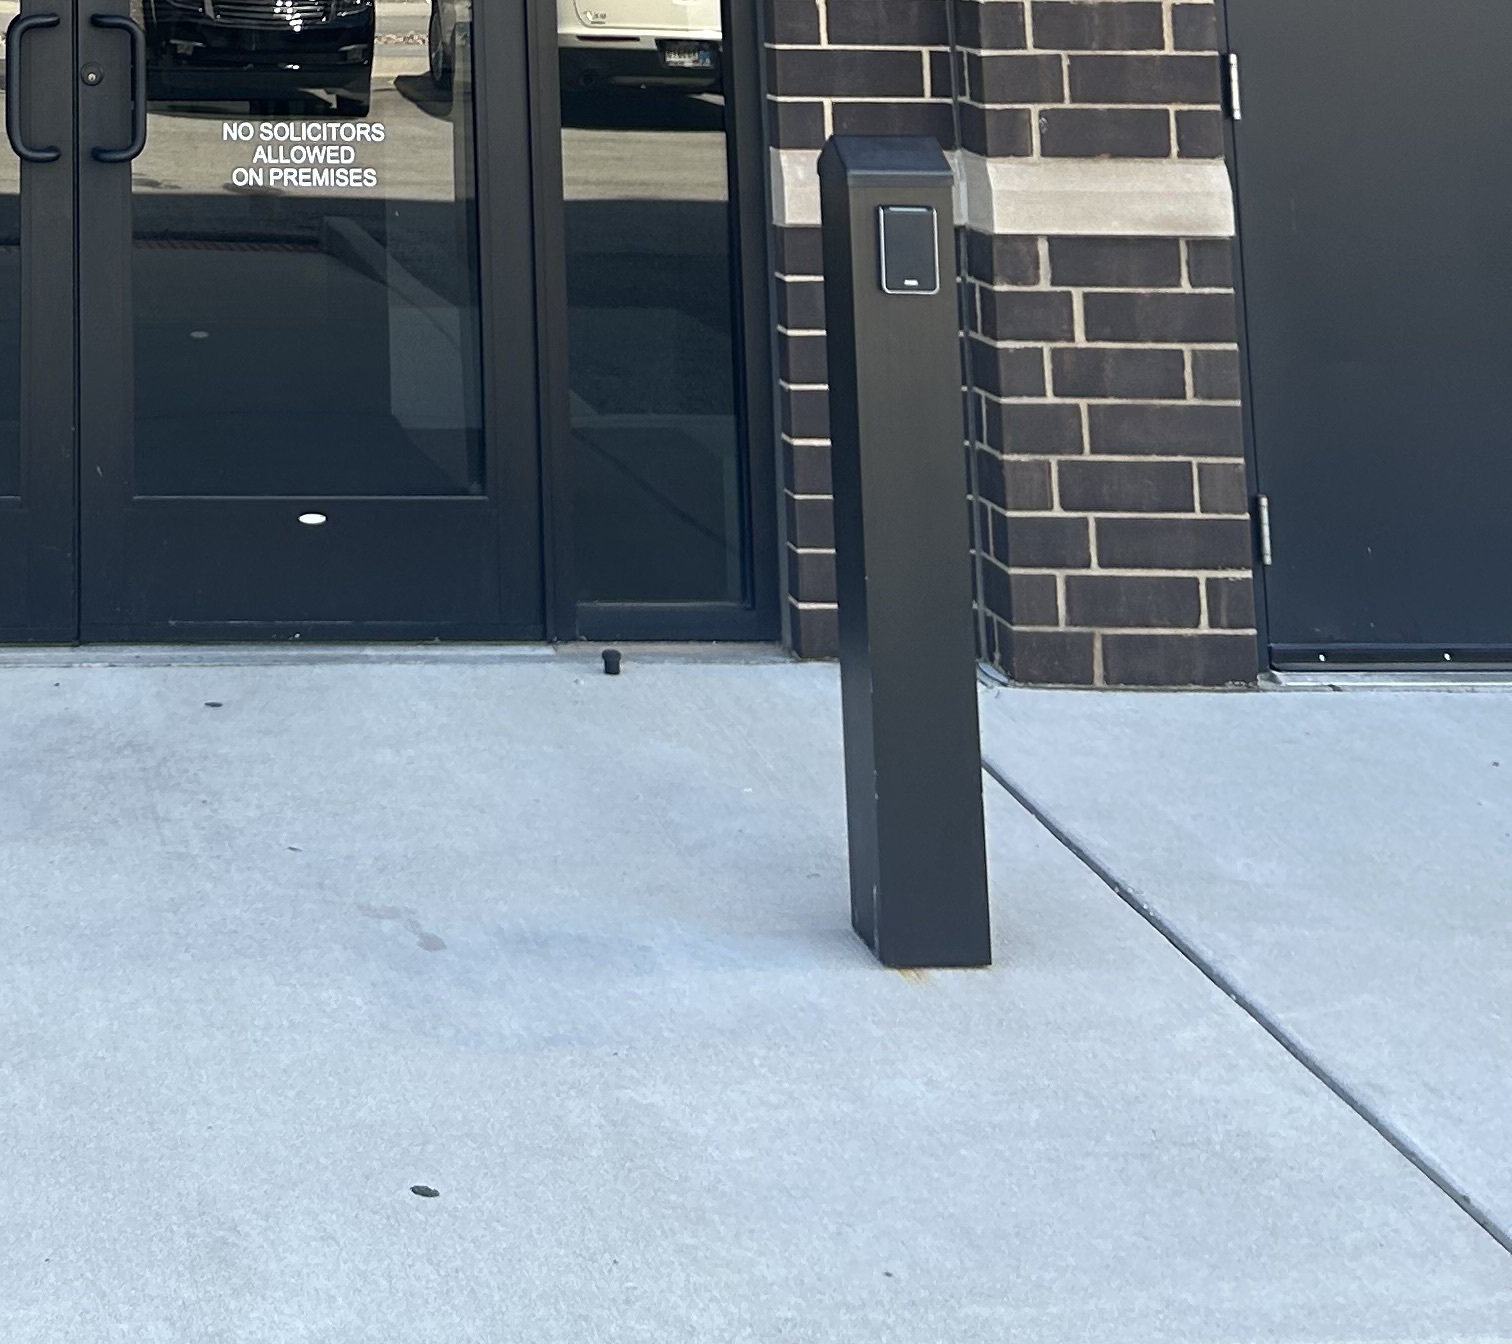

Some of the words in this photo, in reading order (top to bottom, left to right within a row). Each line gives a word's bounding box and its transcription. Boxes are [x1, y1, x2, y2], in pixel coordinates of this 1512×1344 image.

[222, 122, 255, 141] NO
[259, 122, 385, 141] SOLICITORS
[252, 145, 356, 164] ALLOWED
[232, 168, 264, 187] ON
[269, 168, 378, 187] PREMISES
